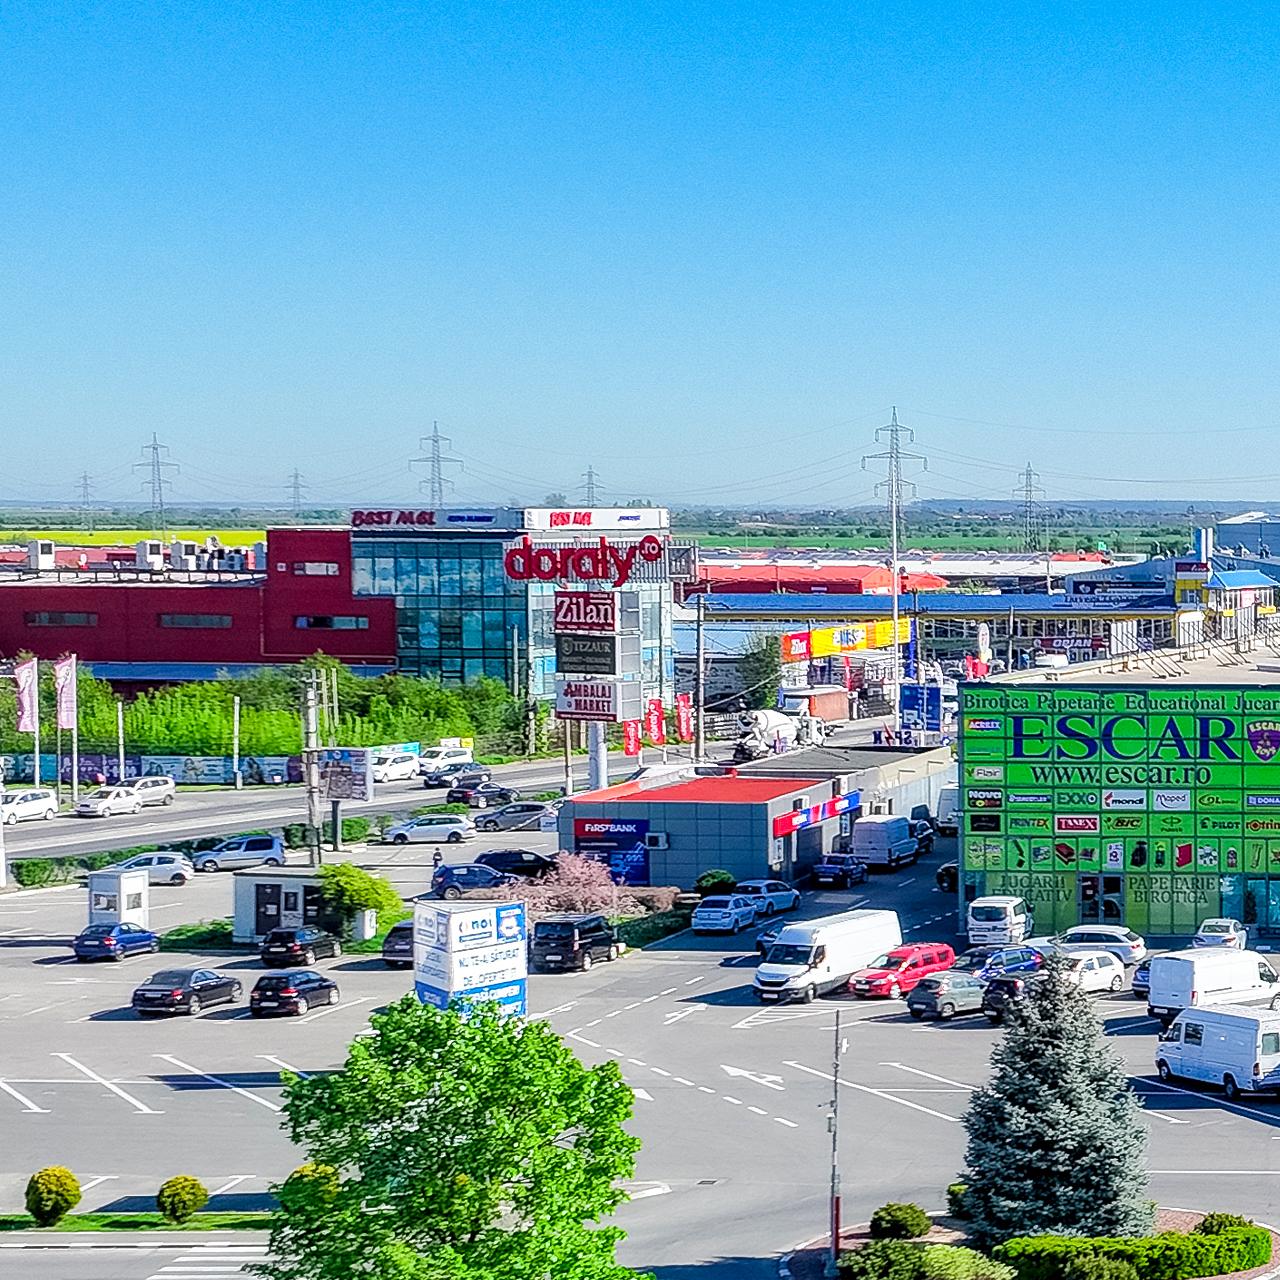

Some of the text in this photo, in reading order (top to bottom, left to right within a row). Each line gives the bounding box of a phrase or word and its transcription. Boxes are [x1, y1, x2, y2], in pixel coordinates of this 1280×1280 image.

[504, 534, 641, 588] doraly
[963, 694, 1030, 709] Birotica
[1037, 694, 1115, 712] Papetarie
[1125, 694, 1226, 711] Educational
[1007, 715, 1243, 761] ESCAR
[1031, 765, 1212, 785] www.escar.ro
[1130, 876, 1216, 890] PAPETARIE
